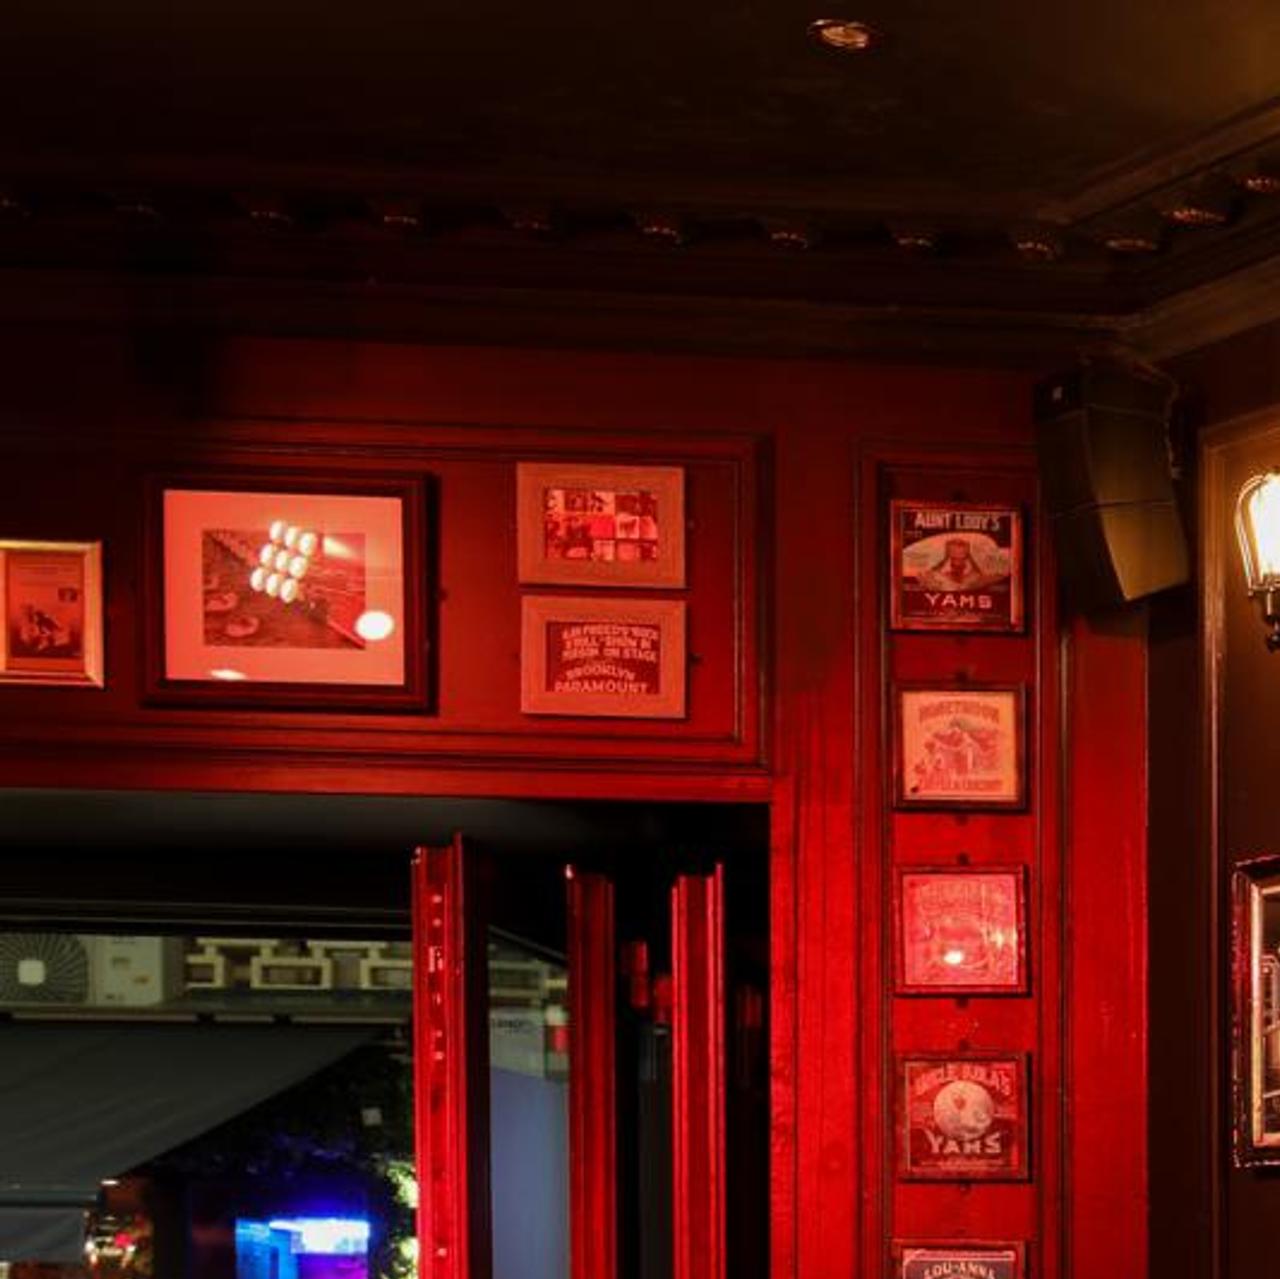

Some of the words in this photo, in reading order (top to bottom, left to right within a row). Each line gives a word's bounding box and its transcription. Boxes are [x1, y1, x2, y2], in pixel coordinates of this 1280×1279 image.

[924, 592, 993, 609] YAMS
[554, 680, 649, 693] PARAMOUNT
[924, 1129, 1001, 1155] YAMS
